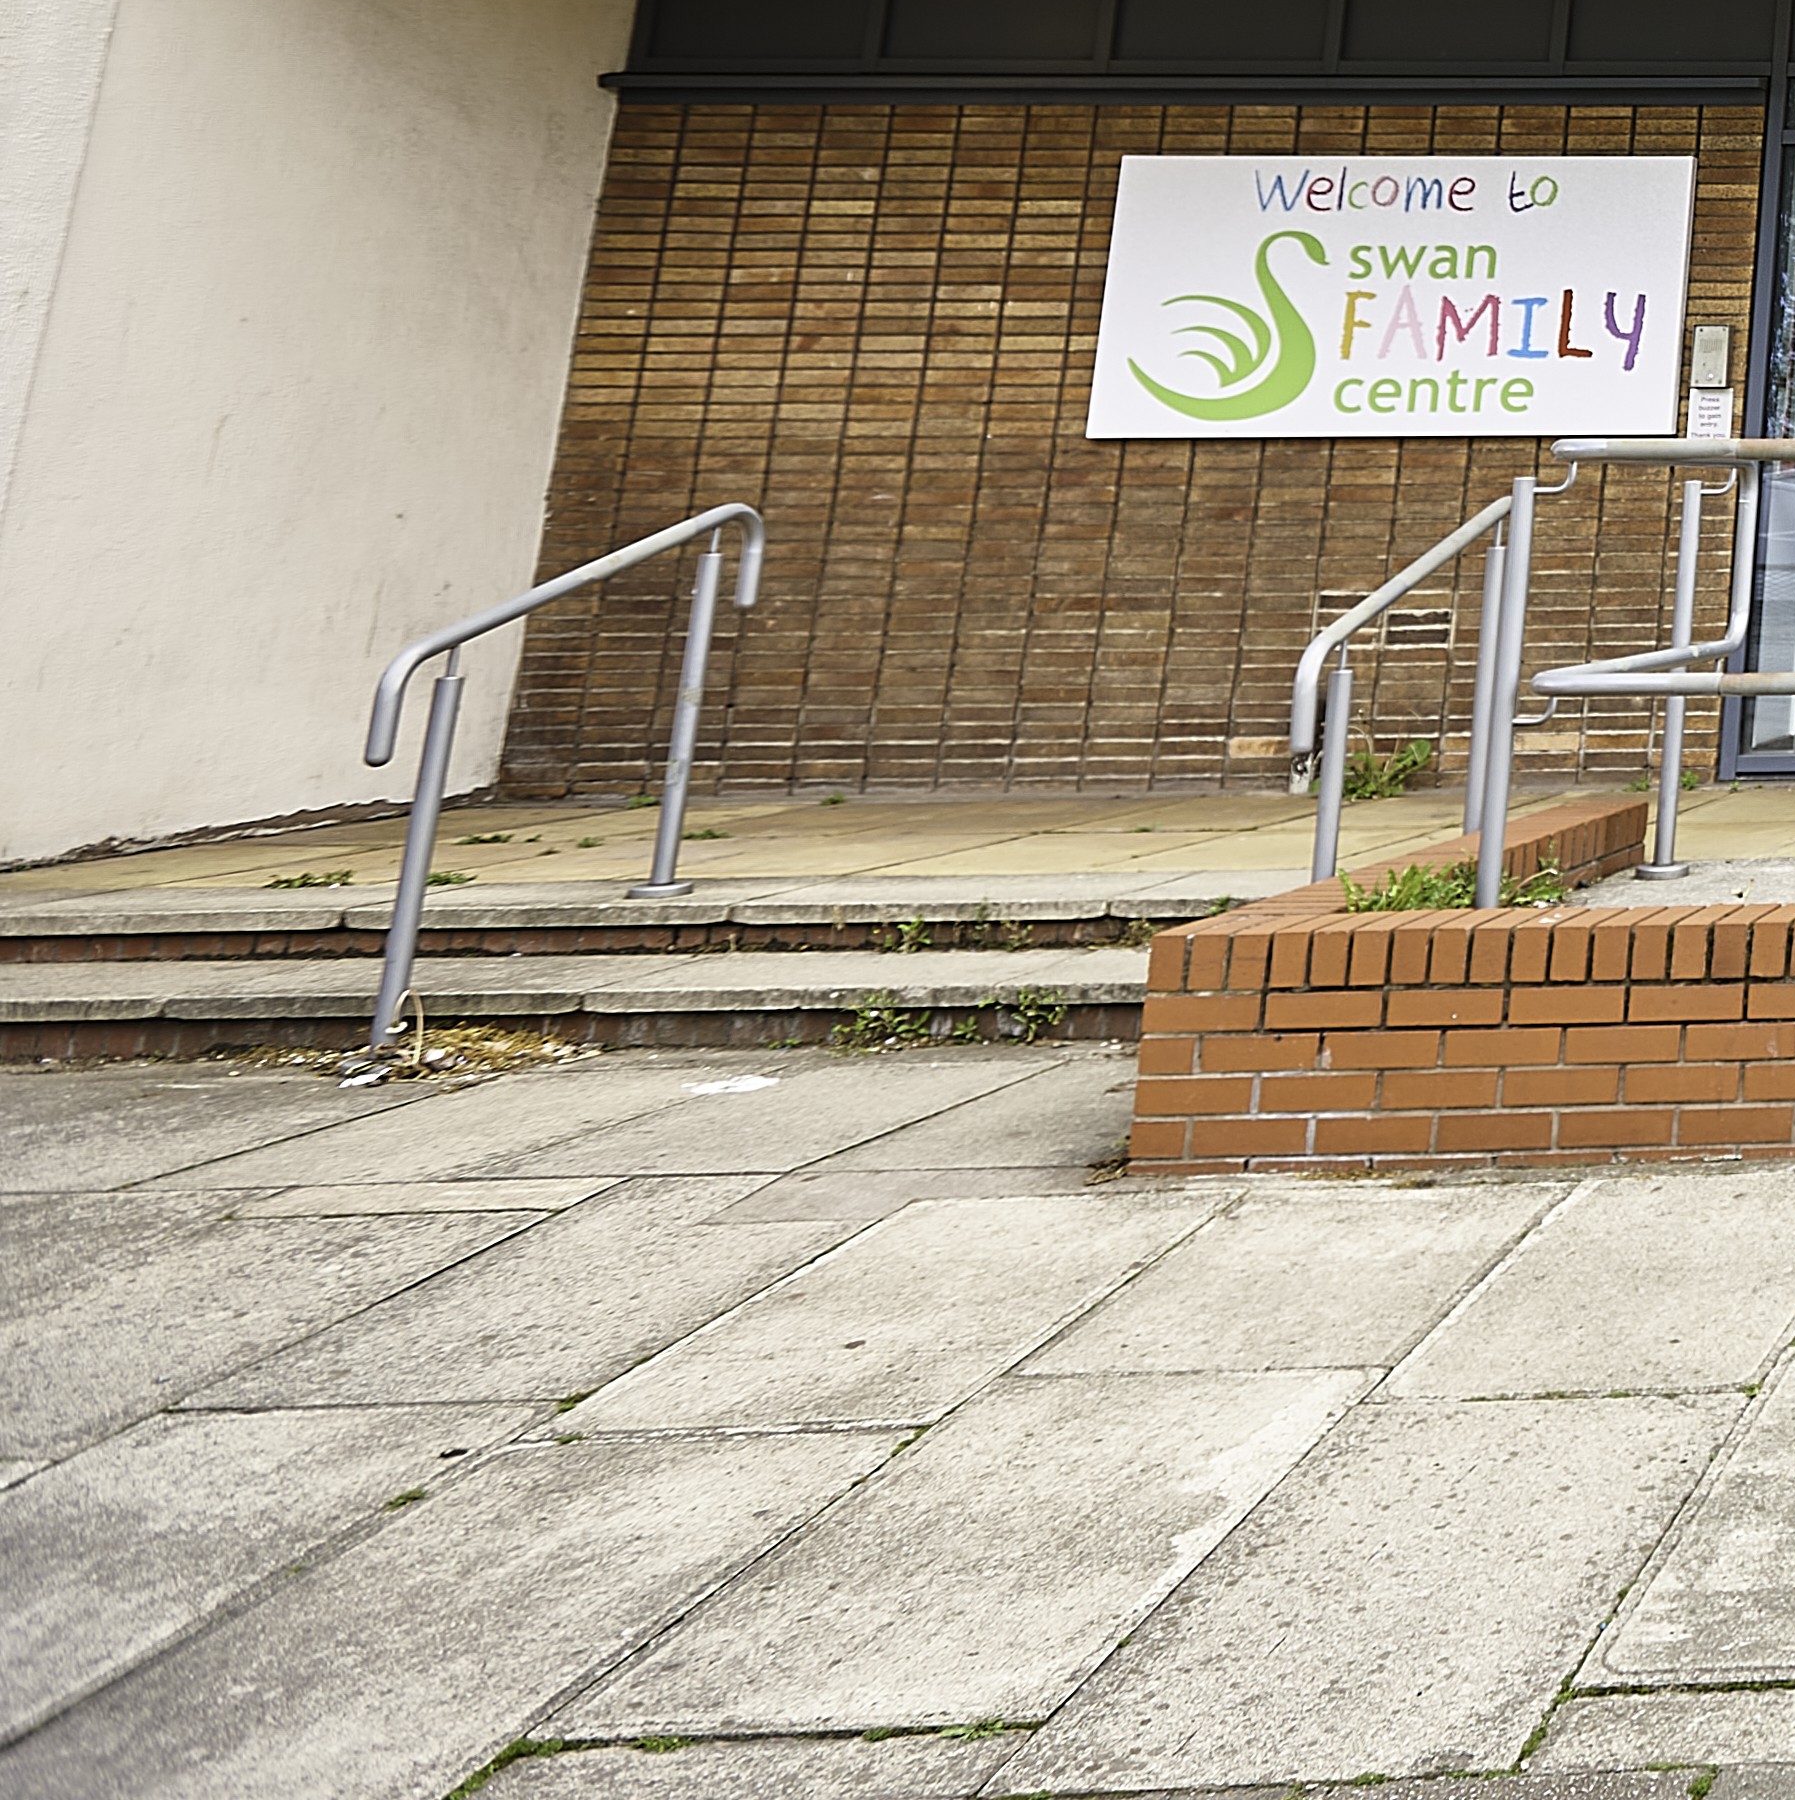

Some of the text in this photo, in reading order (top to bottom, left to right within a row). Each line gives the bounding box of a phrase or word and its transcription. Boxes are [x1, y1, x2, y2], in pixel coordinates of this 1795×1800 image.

[1254, 166, 1559, 213] Welcome to
[1347, 243, 1498, 280] swan
[1339, 284, 1647, 371] FAMILY
[1333, 369, 1535, 414] centre
